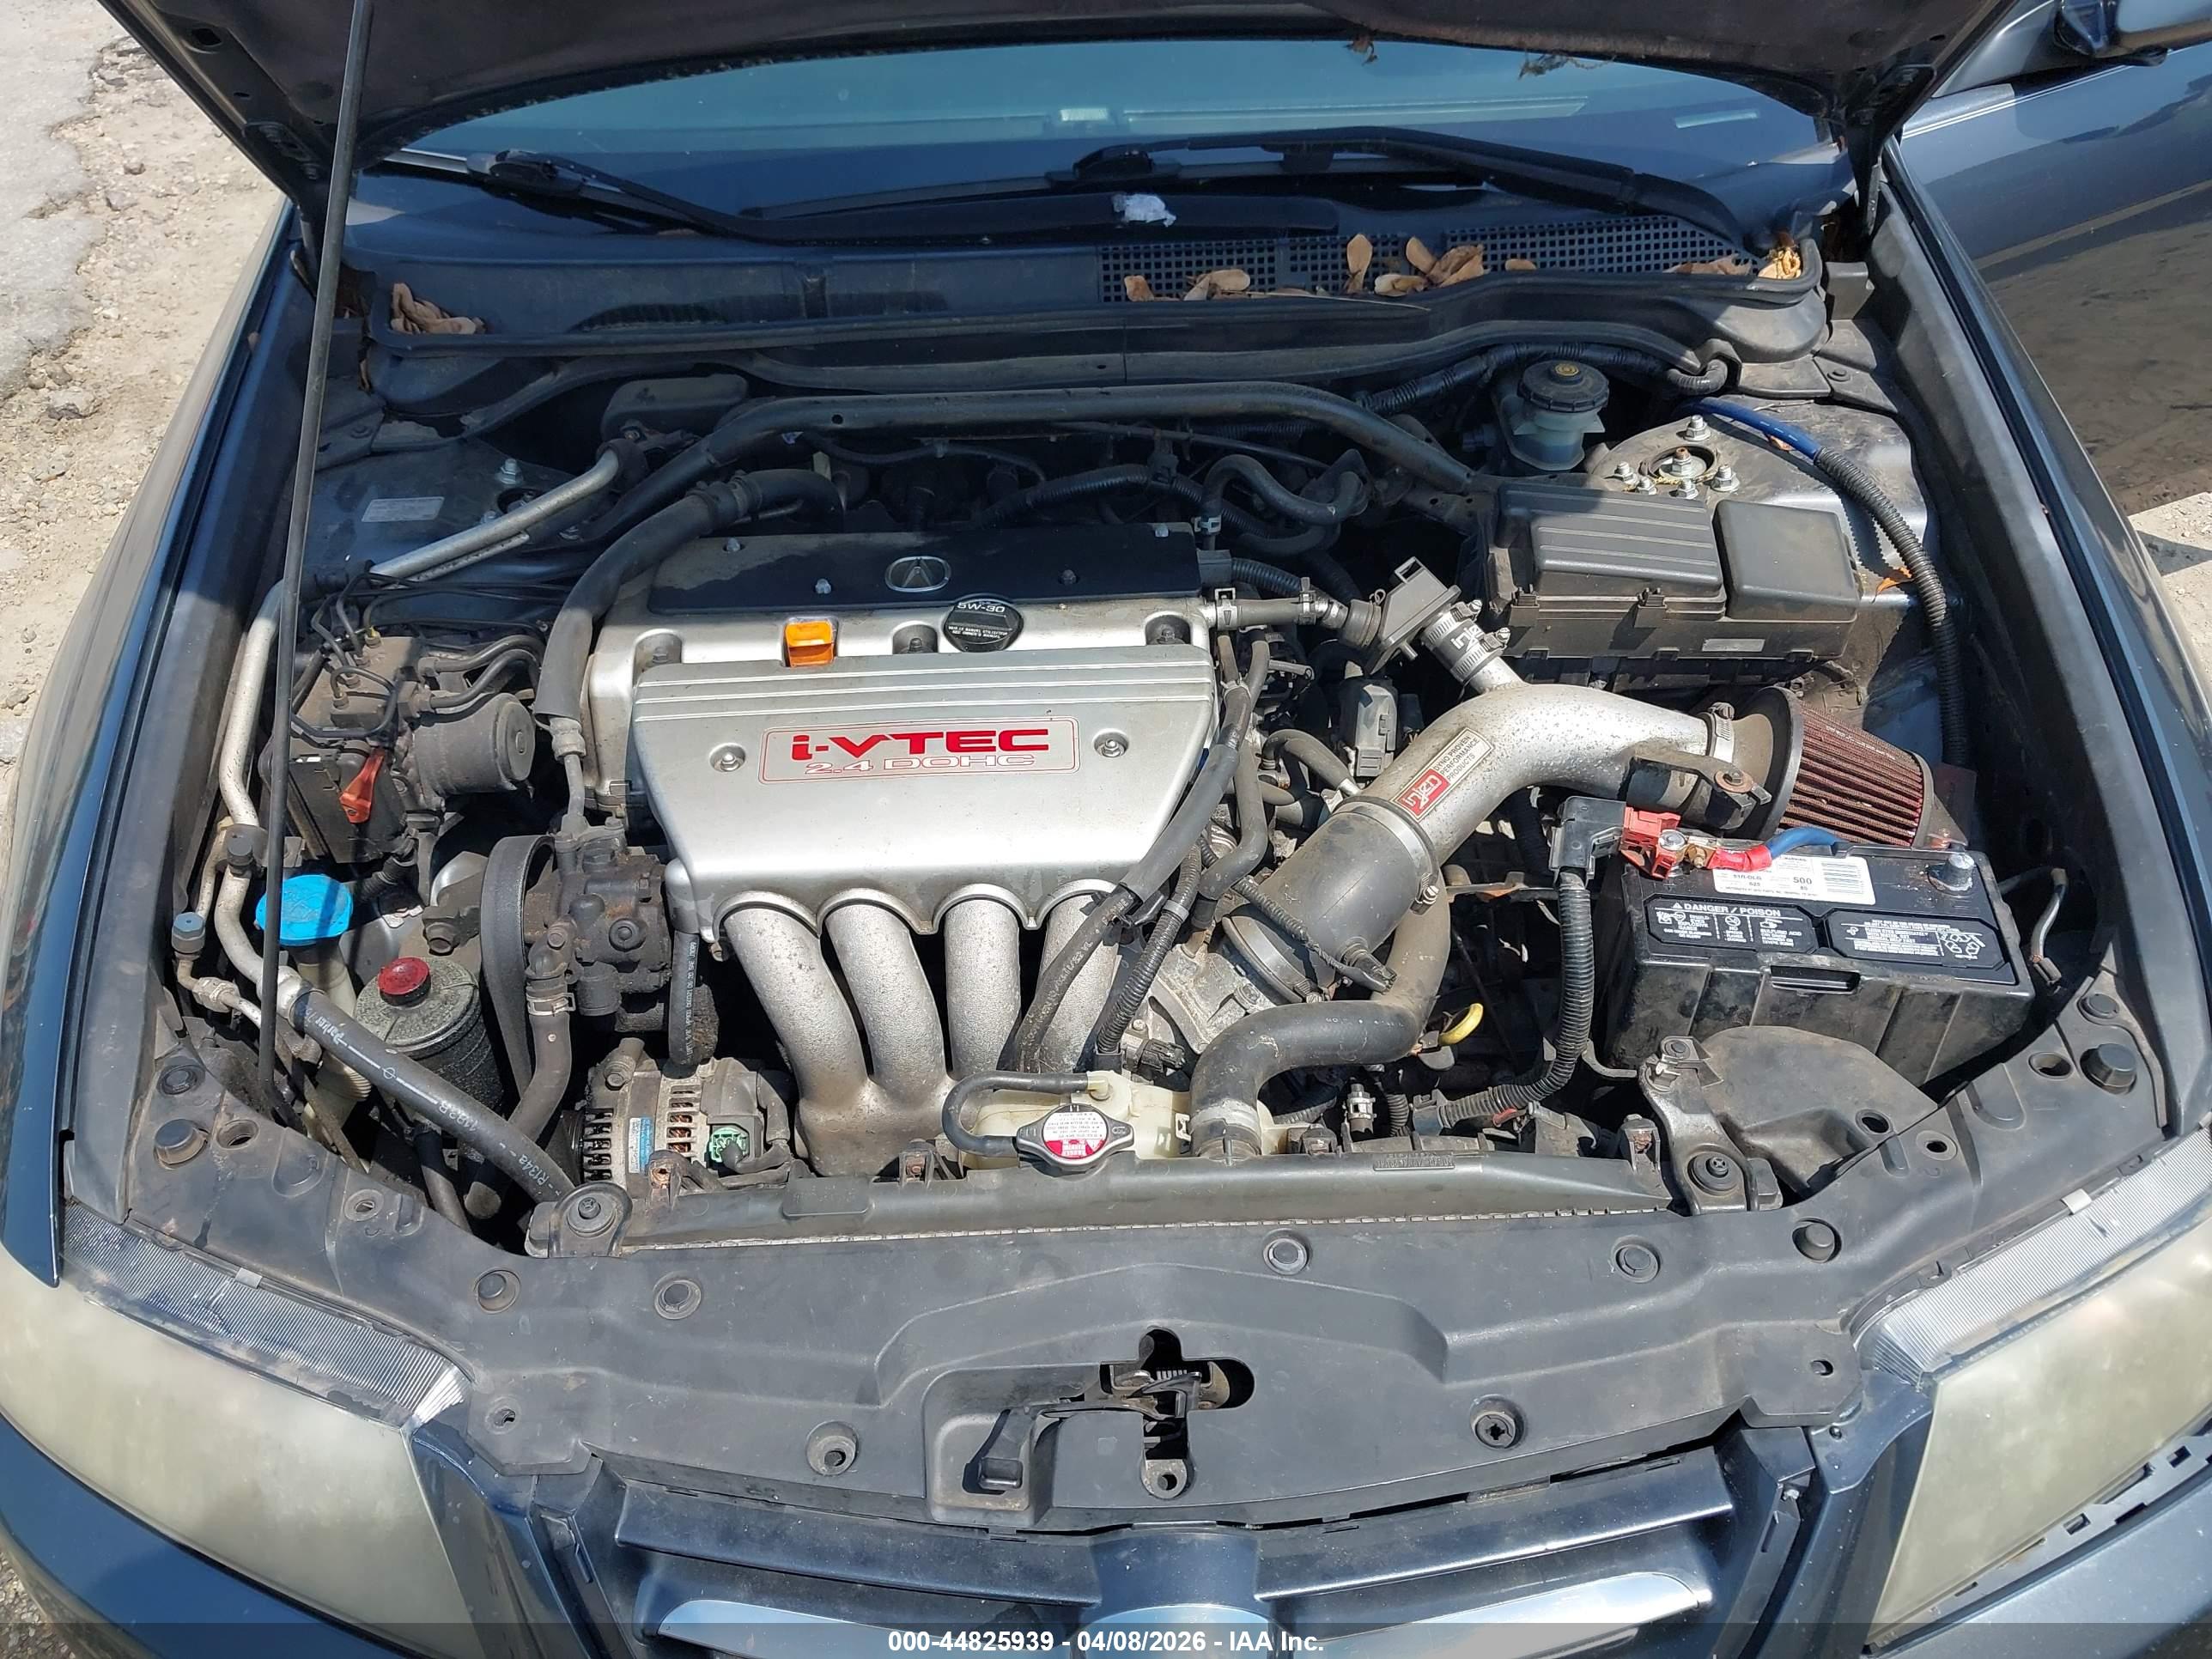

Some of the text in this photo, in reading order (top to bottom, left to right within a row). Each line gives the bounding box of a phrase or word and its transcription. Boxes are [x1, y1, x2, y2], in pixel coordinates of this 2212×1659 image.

[957, 602, 1006, 613] 5W-30
[792, 729, 1048, 761] i-VTEC
[1433, 736, 1471, 771] DYNO PROVEN
[1439, 738, 1480, 775] PERFORMANCE
[805, 754, 1036, 775] 2.4 DOHC
[1447, 753, 1476, 781] PRODUCTS
[1793, 876, 1813, 884] 500
[1684, 903, 1729, 913] DANGER
[1740, 908, 1781, 917] POISON
[314, 1016, 346, 1044] Parker
[519, 1153, 551, 1188] R134a
